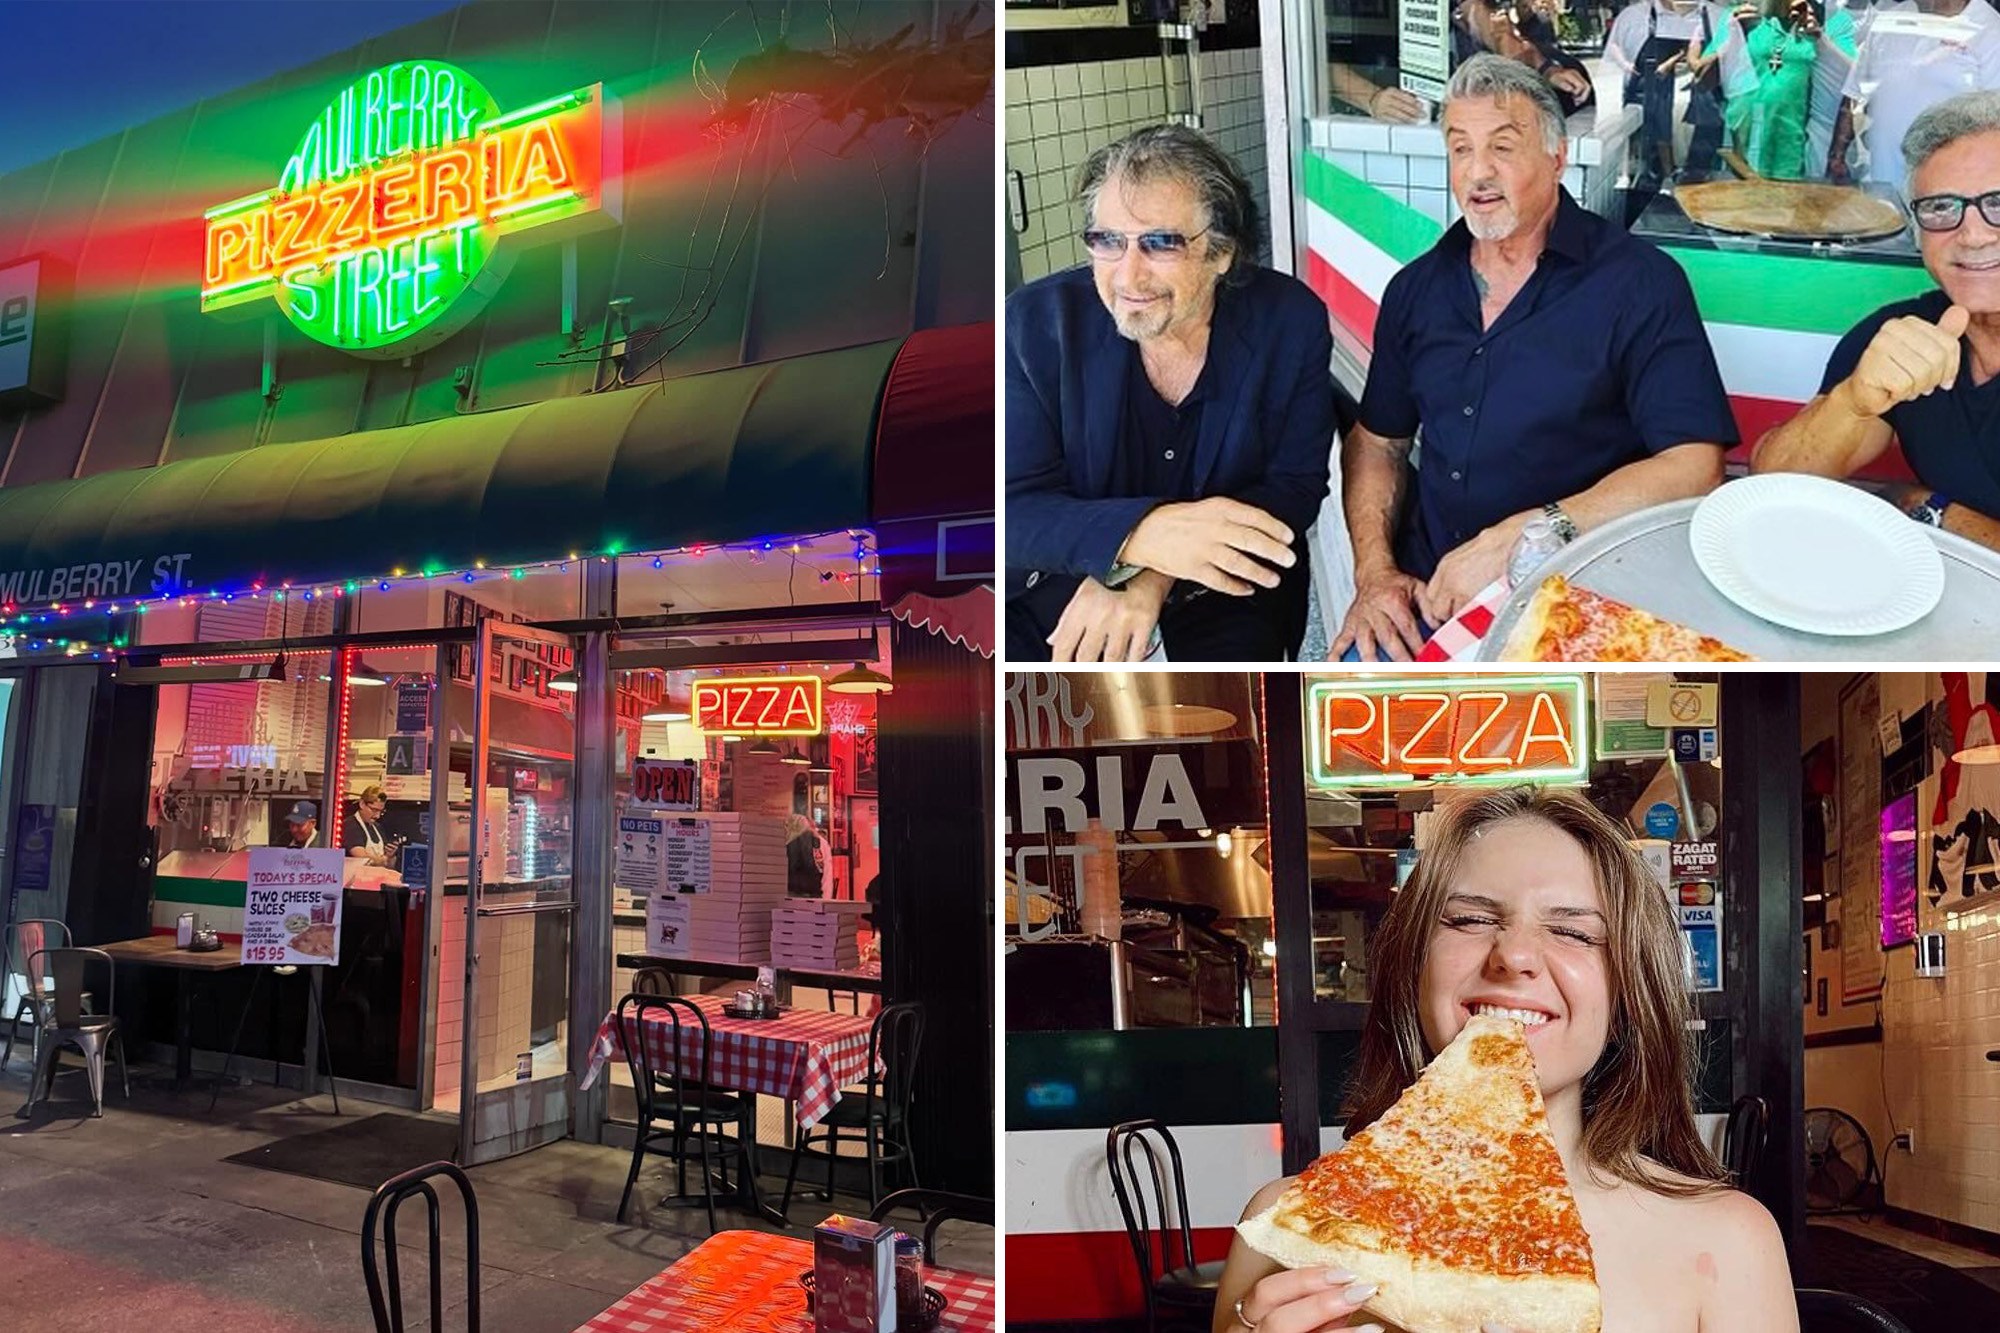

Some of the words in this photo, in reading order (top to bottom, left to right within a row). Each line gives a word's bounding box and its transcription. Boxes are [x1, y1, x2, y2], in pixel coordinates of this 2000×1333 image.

[278, 64, 481, 191] MULBERRY
[205, 120, 571, 284] PIZZERIA
[282, 217, 479, 339] STREET
[0, 559, 143, 604] MULBERRY
[151, 553, 193, 592] ST.
[697, 686, 815, 727] PIZZA
[1325, 692, 1574, 766] PIZZA
[391, 745, 408, 767] A
[635, 766, 694, 804] OPEN
[1005, 754, 1208, 834] RIA
[622, 820, 634, 829] NO
[637, 821, 660, 832] PETS
[1673, 843, 1717, 855] ZAGAT
[1673, 854, 1718, 866] RATED
[254, 872, 295, 883] TODAY'S
[298, 873, 338, 884] SPECIAL
[251, 891, 279, 902] TWO
[281, 891, 322, 903] CHEESE
[249, 903, 286, 915] SLICES
[1684, 910, 1714, 921] VISA
[246, 946, 286, 961] $15.95
